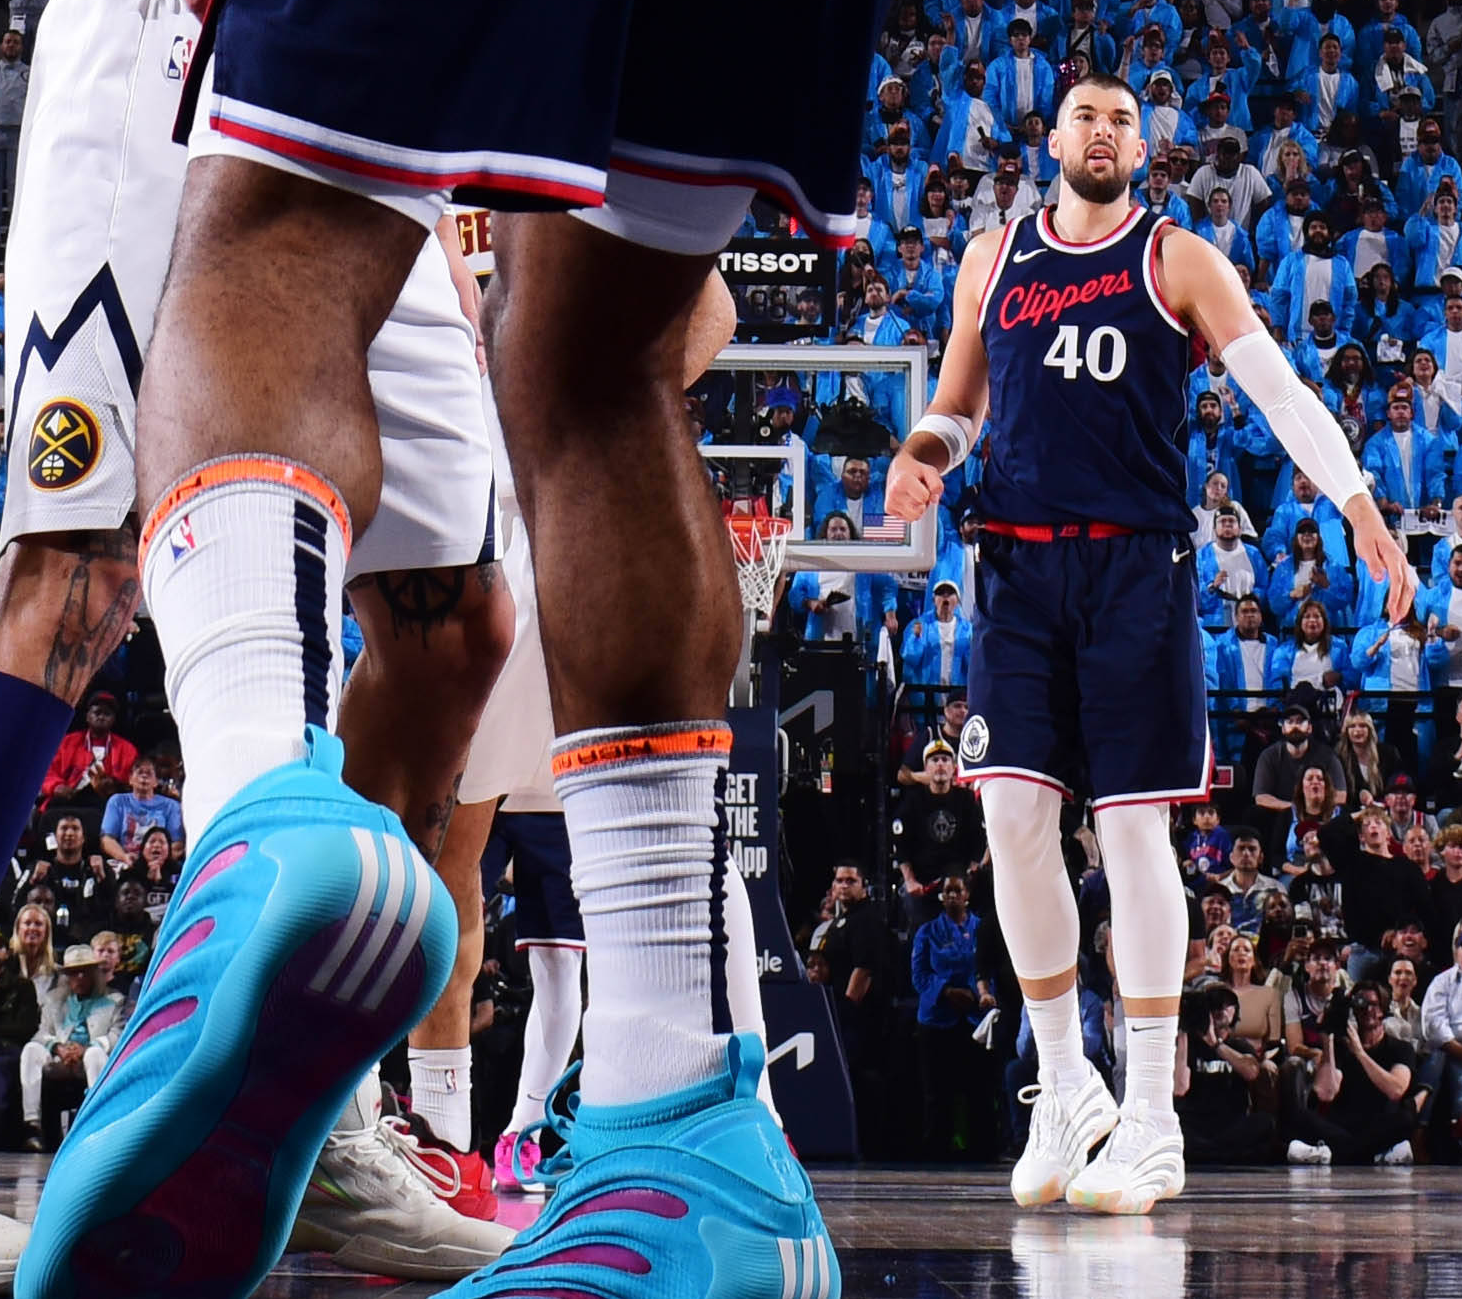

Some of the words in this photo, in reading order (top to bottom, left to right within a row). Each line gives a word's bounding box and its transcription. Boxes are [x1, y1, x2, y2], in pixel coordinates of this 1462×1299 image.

[717, 252, 819, 274] TISSOT
[998, 267, 1136, 332] Clippers
[1043, 324, 1128, 383] 40
[724, 773, 759, 804] GET
[725, 806, 759, 837] THE
[734, 847, 768, 878] App
[757, 950, 783, 978] gle
